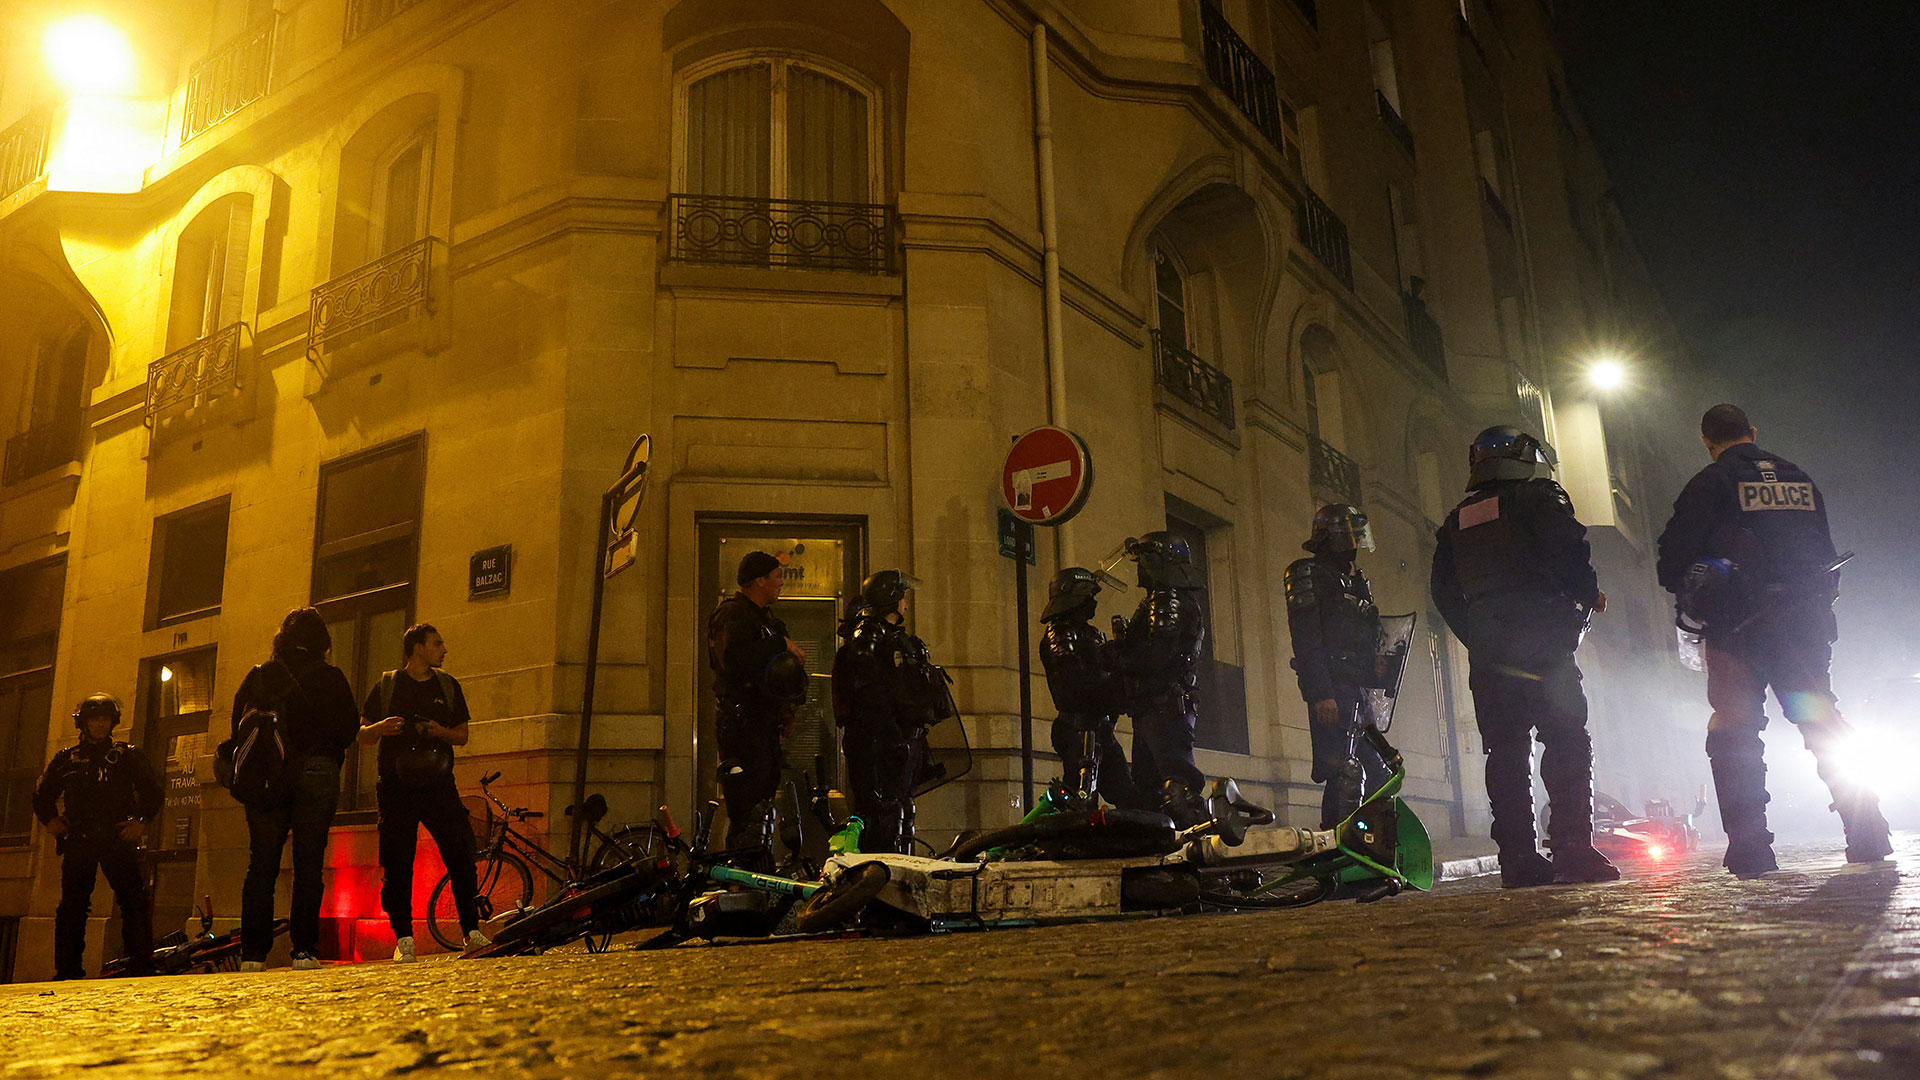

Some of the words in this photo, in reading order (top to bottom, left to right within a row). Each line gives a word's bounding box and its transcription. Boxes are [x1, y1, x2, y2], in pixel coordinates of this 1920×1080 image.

[1743, 485, 1811, 507] POLICE
[482, 558, 497, 570] RUE
[475, 572, 503, 587] BALZAC
[182, 762, 195, 775] AU
[757, 877, 792, 893] TIER
